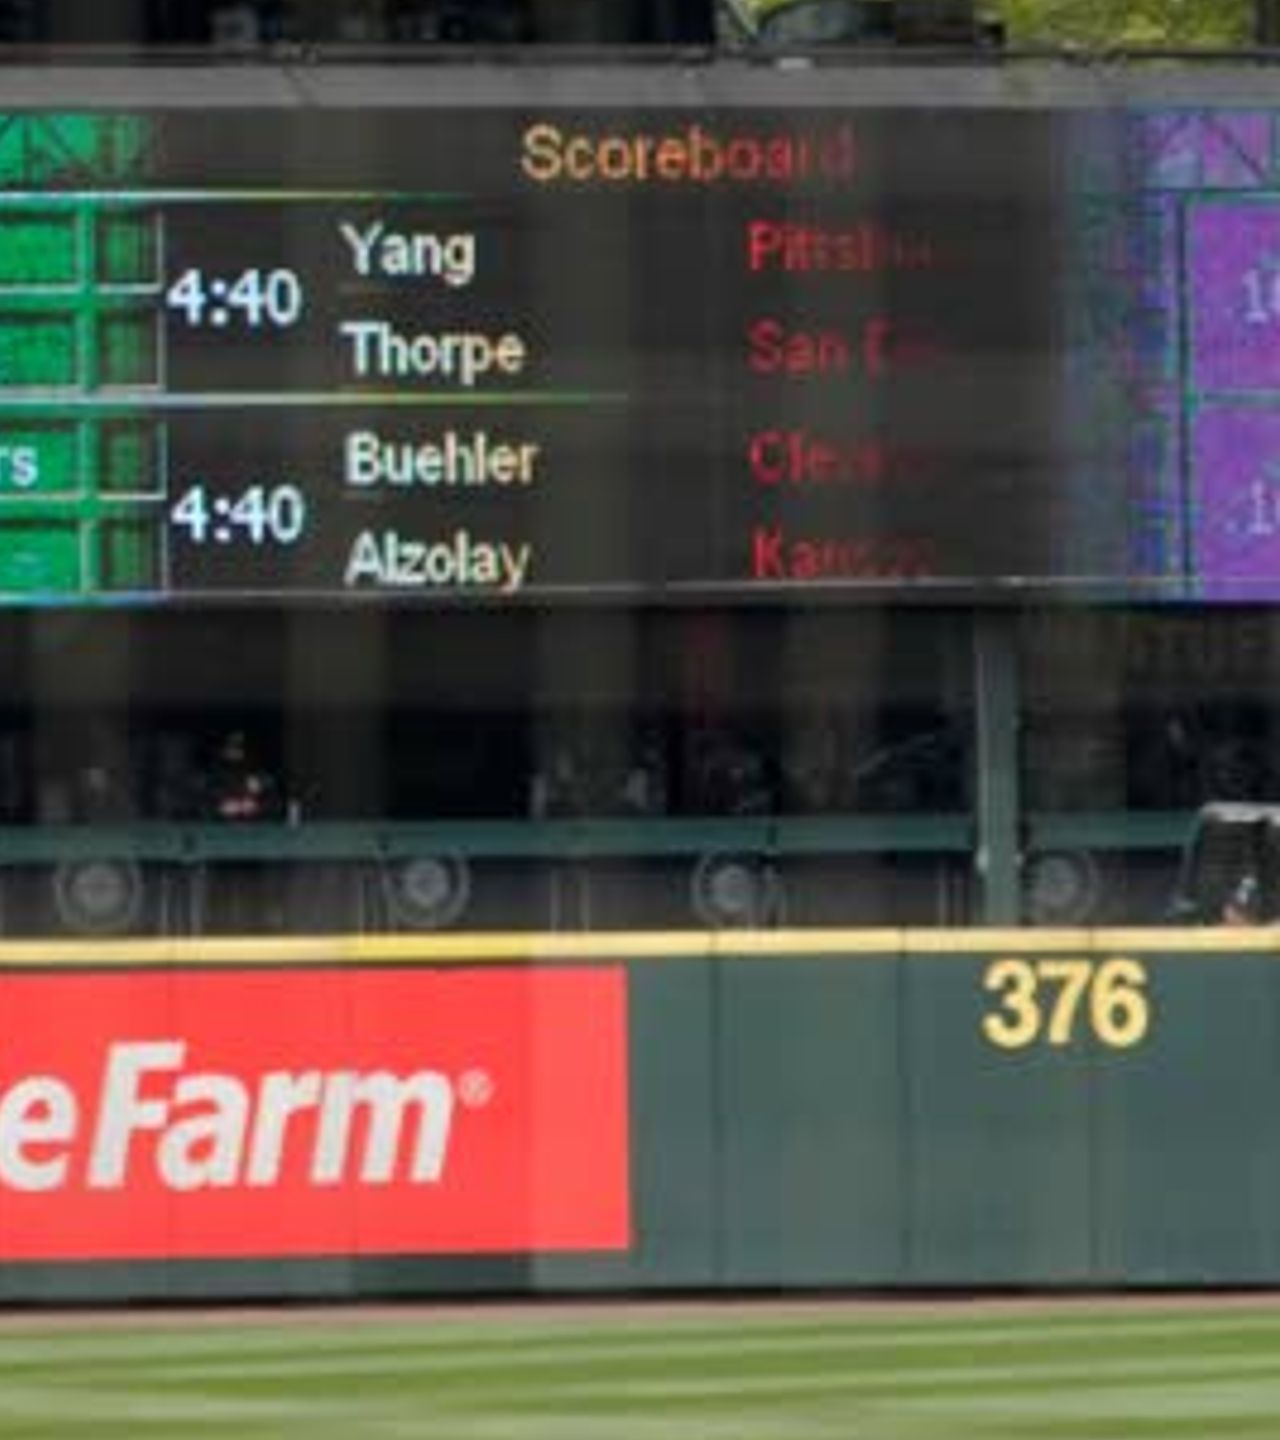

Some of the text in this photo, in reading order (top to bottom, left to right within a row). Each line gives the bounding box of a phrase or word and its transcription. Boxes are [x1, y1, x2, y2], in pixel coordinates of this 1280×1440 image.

[340, 222, 476, 285] Yang
[167, 267, 302, 326] 4:40
[340, 320, 526, 386] Thorpe
[346, 431, 539, 486] Buehler
[170, 483, 304, 544] 4:40
[343, 528, 530, 592] Alzolay
[983, 958, 1148, 1048] 376
